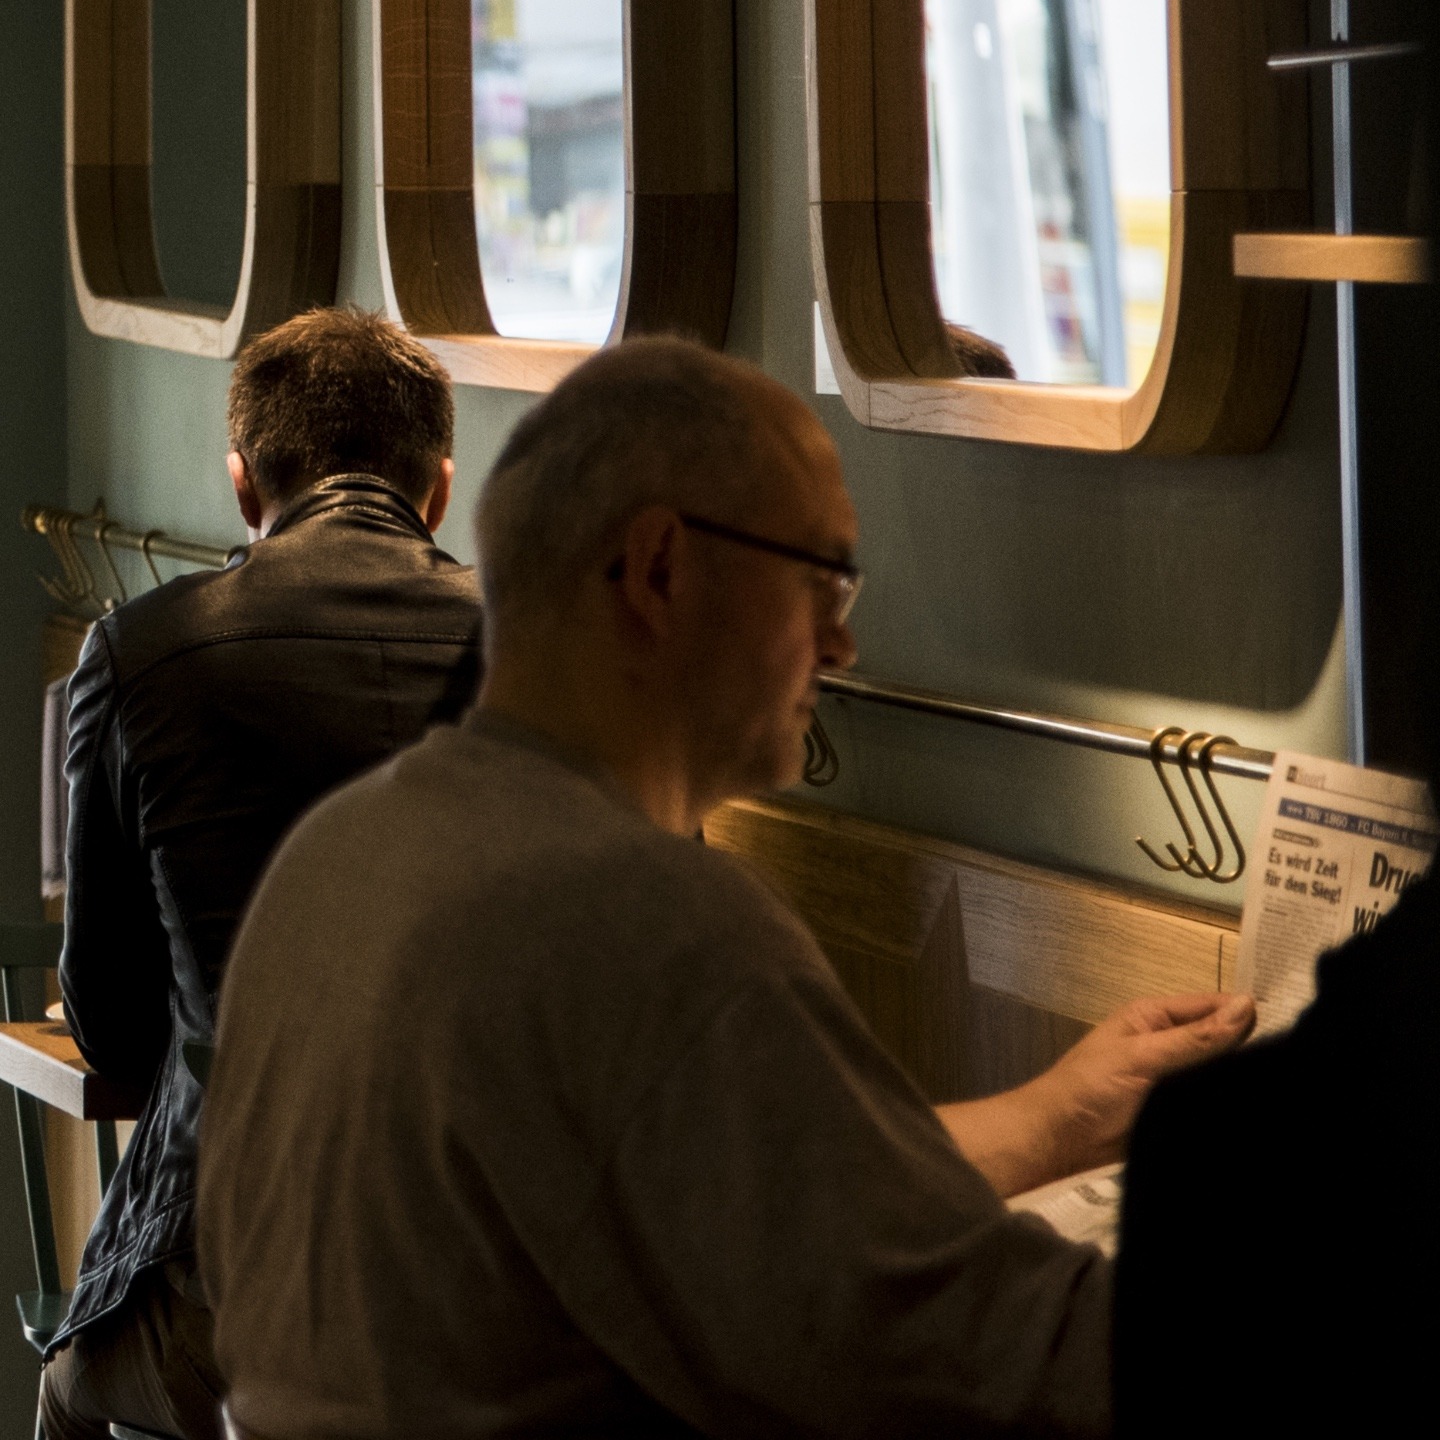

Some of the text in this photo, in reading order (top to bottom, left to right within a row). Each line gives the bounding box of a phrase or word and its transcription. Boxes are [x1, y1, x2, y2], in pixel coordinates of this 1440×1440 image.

[1268, 847, 1338, 880] Es wird Zeit
[1352, 901, 1382, 933] wi
